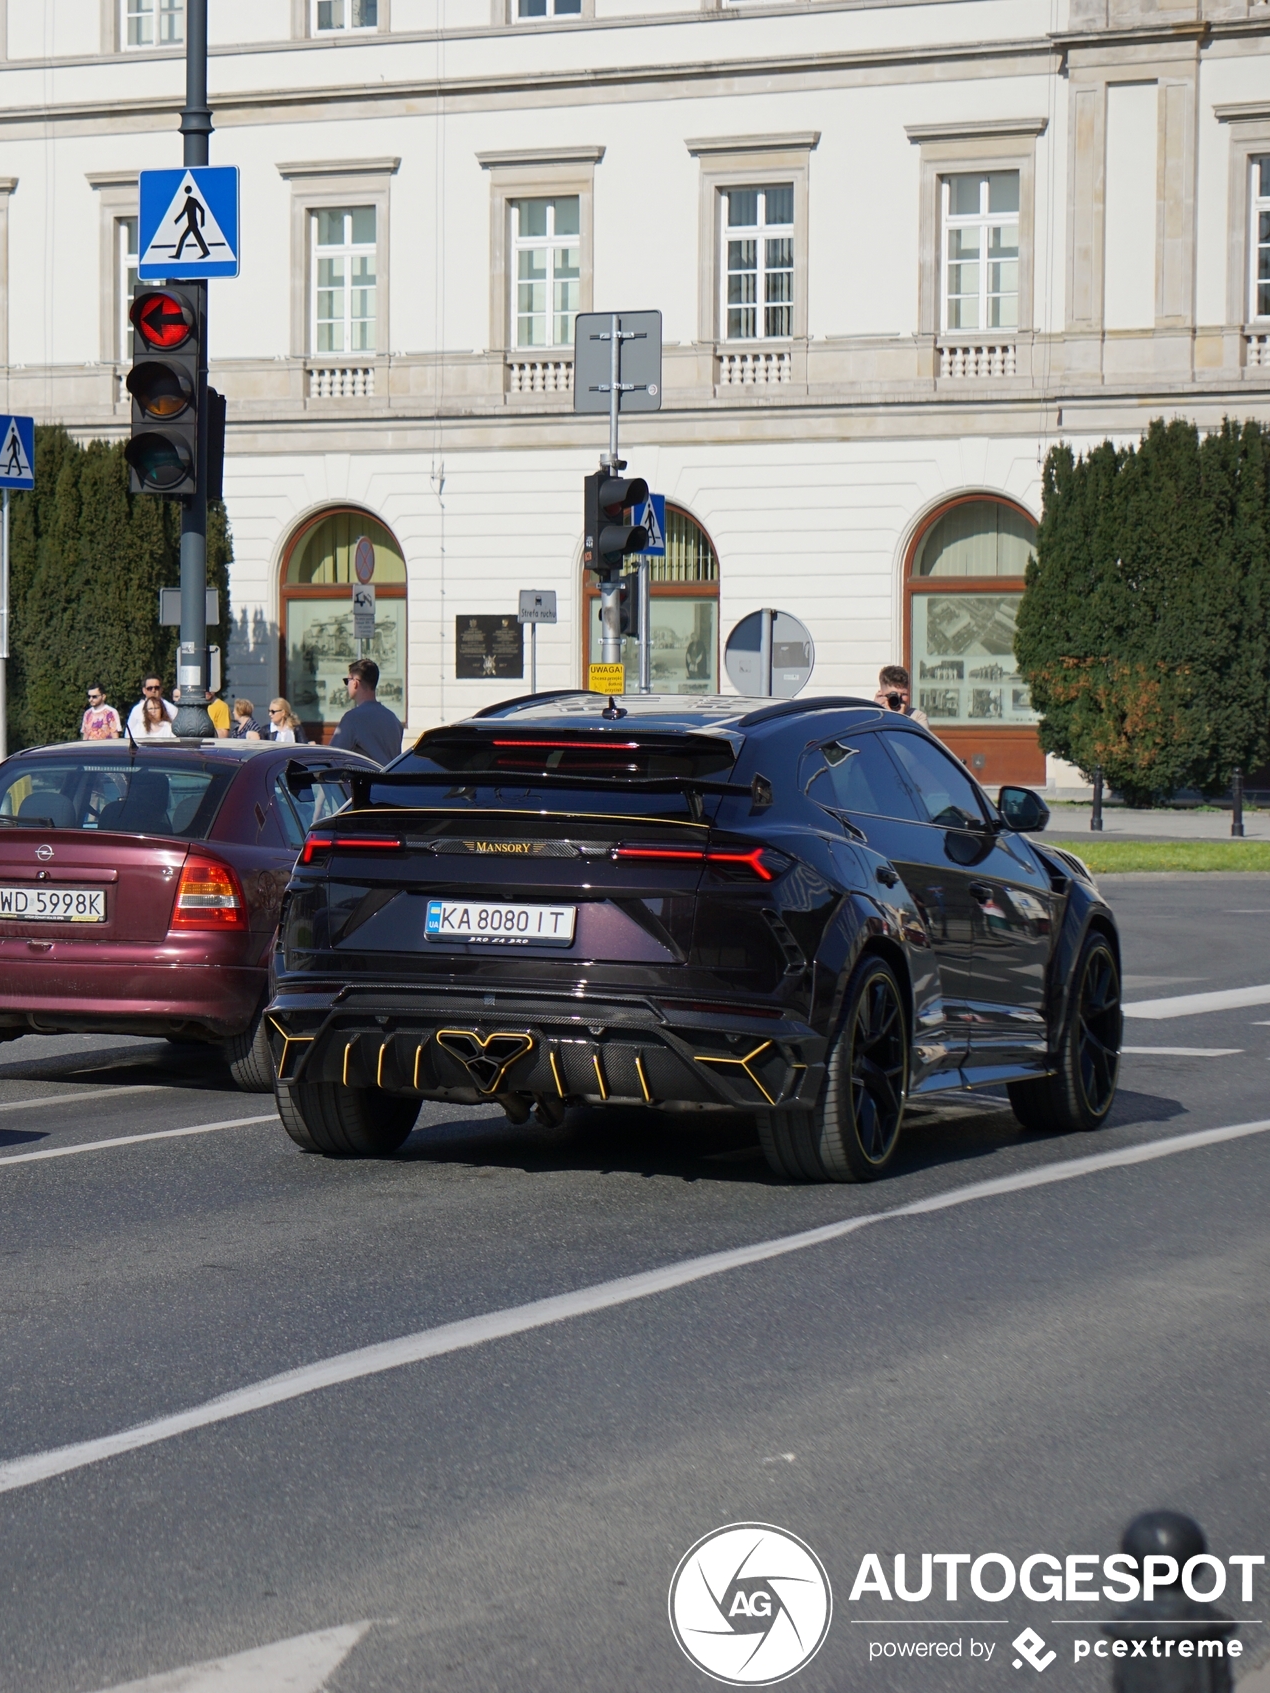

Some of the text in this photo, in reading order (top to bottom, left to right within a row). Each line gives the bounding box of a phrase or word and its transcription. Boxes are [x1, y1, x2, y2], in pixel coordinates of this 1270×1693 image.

[521, 608, 556, 618] Strefa ruchu
[476, 842, 530, 853] MANSORY
[0, 891, 100, 915] WD 5998K
[441, 908, 471, 930] KA
[477, 909, 530, 932] 8080
